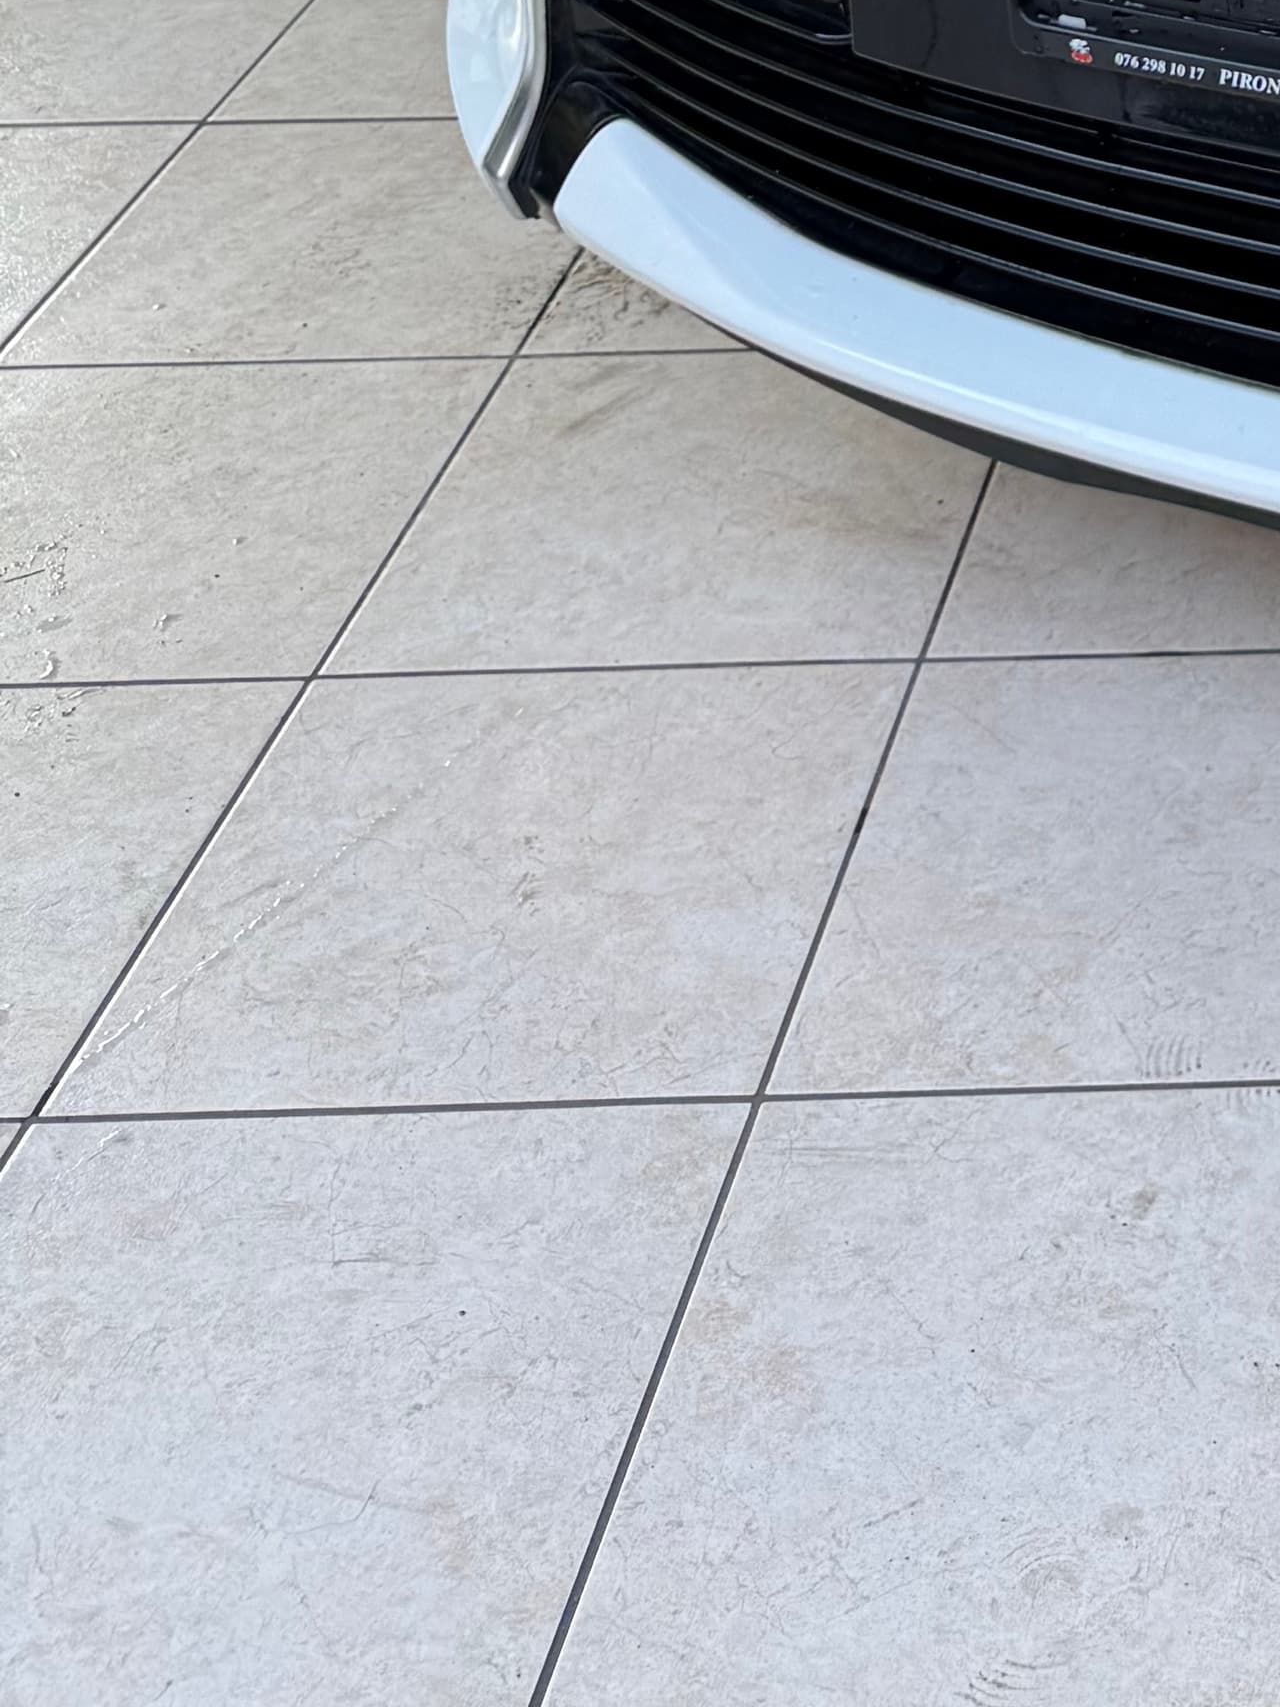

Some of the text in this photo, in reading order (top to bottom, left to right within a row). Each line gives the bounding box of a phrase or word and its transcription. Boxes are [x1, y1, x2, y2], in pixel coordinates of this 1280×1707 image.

[1114, 52, 1139, 69] 076
[1142, 57, 1166, 74] 298
[1170, 62, 1186, 77] 10
[1189, 66, 1205, 81] 17
